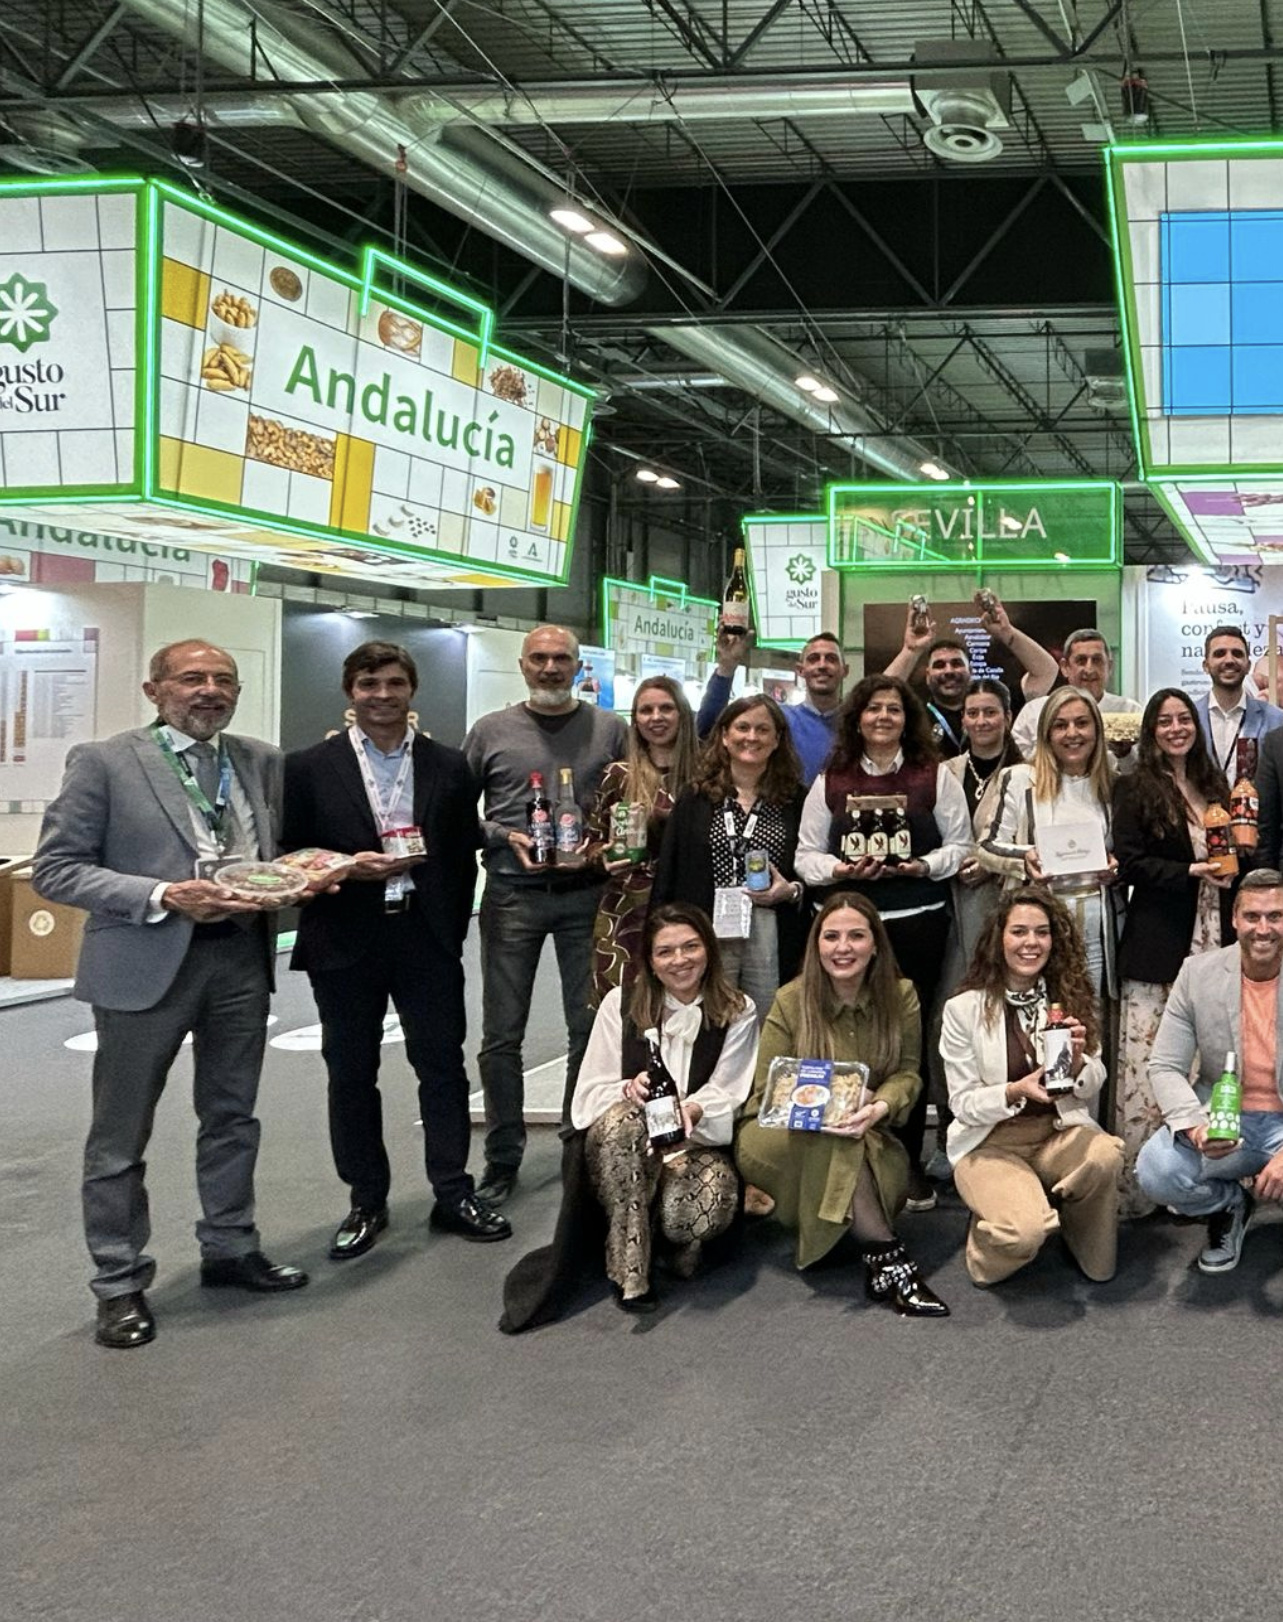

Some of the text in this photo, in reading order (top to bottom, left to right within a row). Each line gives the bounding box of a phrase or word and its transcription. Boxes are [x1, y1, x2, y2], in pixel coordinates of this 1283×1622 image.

[0, 357, 64, 394] usto
[14, 385, 67, 413] Sur
[284, 344, 516, 469] Andalucía
[785, 587, 818, 602] gusto
[634, 615, 694, 641] Andalucía
[1254, 623, 1266, 639] y
